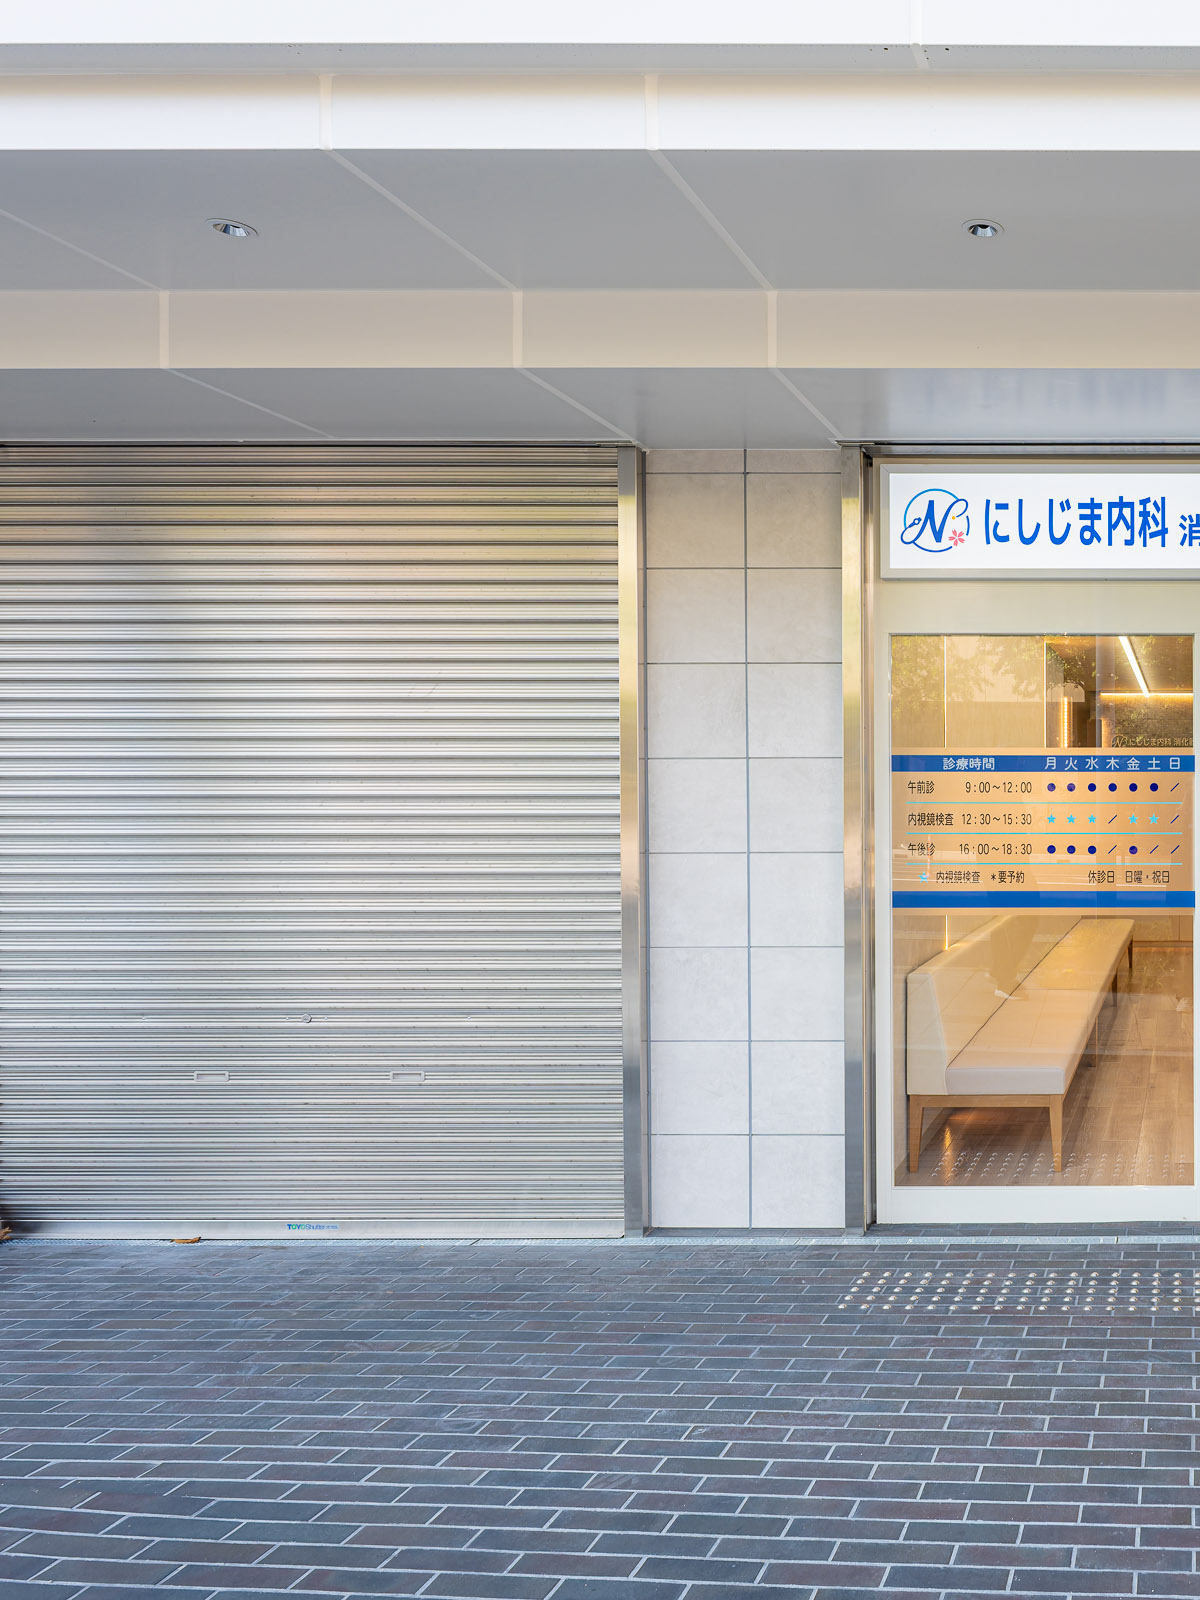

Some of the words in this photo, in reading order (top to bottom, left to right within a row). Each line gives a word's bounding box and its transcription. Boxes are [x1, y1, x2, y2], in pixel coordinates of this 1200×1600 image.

[985, 496, 1168, 547] にしじま内科
[943, 757, 995, 770] 診療時間
[1045, 757, 1056, 770] 月
[1064, 757, 1078, 770] 火
[1085, 757, 1099, 770] 水
[1106, 757, 1119, 770] 木
[1127, 757, 1140, 770] 金
[1148, 757, 1160, 770] 土
[1169, 757, 1180, 770] 日
[908, 781, 935, 794] 午前診
[908, 813, 954, 826] 内視鏡検査
[908, 843, 935, 856] 午後診
[936, 871, 980, 883] 内視鏡検査
[1088, 870, 1115, 883] 休診日
[1126, 870, 1169, 883] 日曜・祝日
